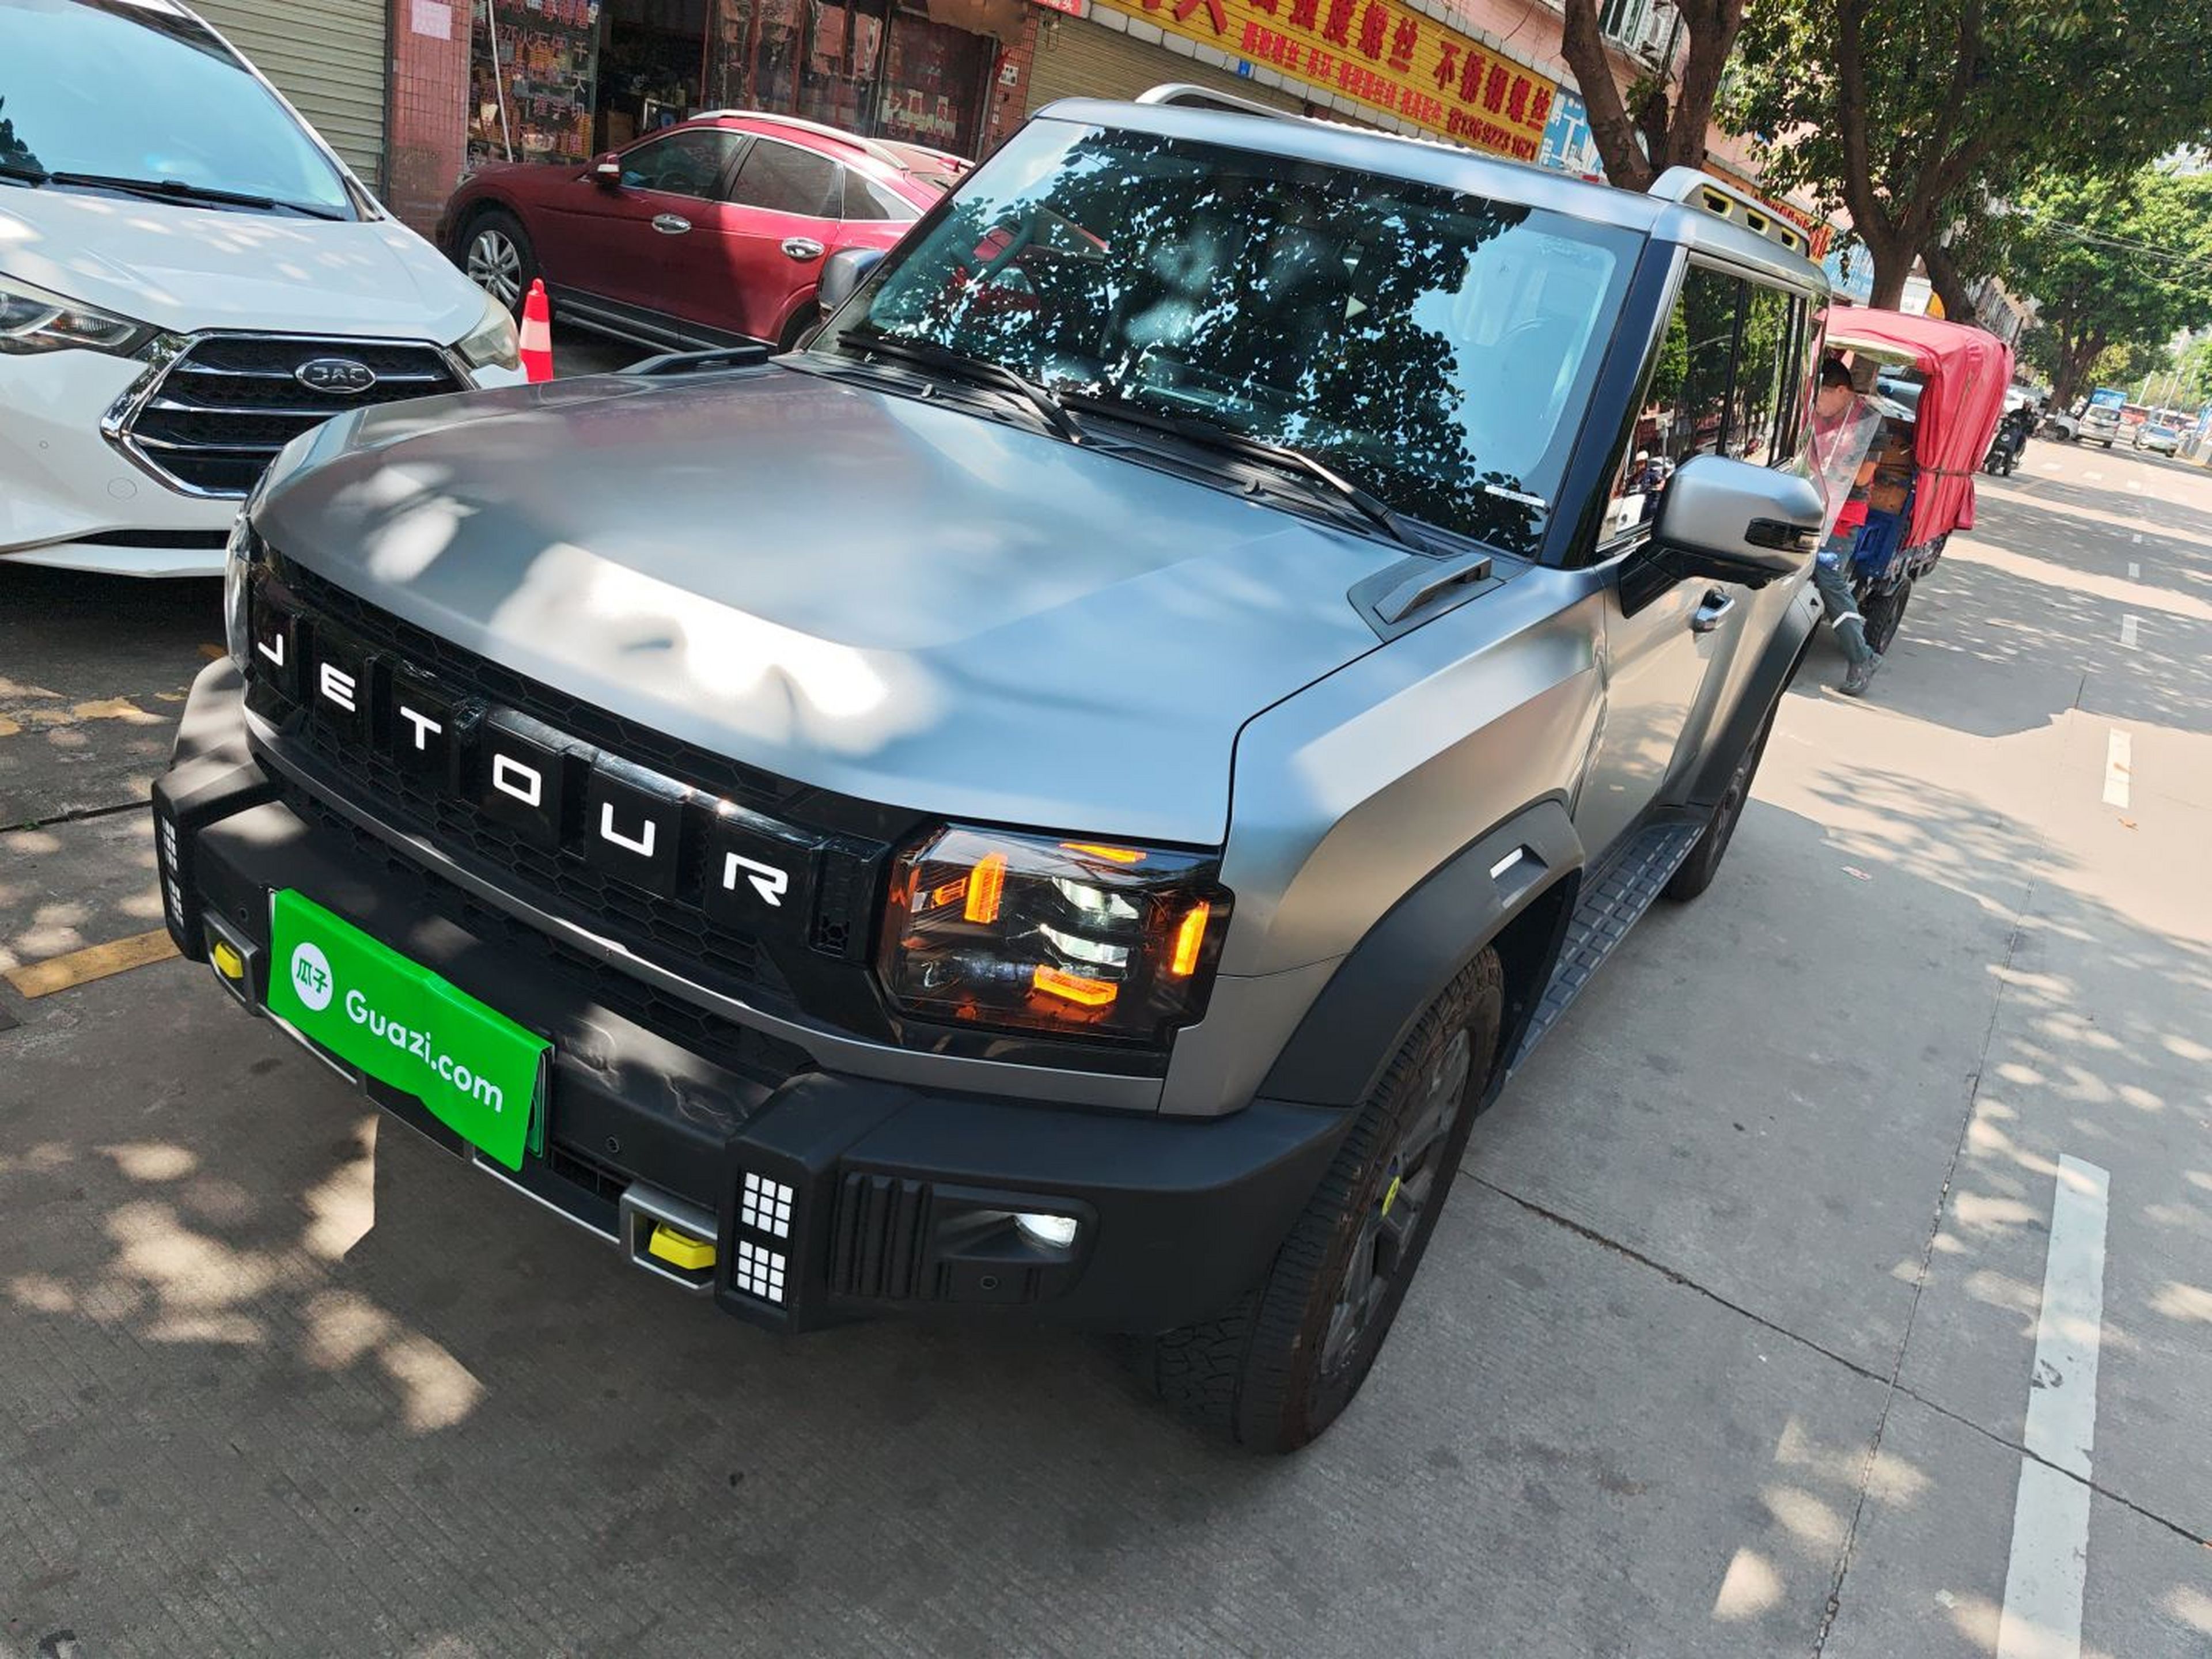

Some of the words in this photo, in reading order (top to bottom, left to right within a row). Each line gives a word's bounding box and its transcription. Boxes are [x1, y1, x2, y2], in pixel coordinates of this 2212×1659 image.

[1433, 41, 1550, 132] 不锈钢螺丝
[257, 633, 789, 907] JETOUR
[296, 957, 328, 994] 瓜子
[345, 989, 503, 1112] Guazi.com
